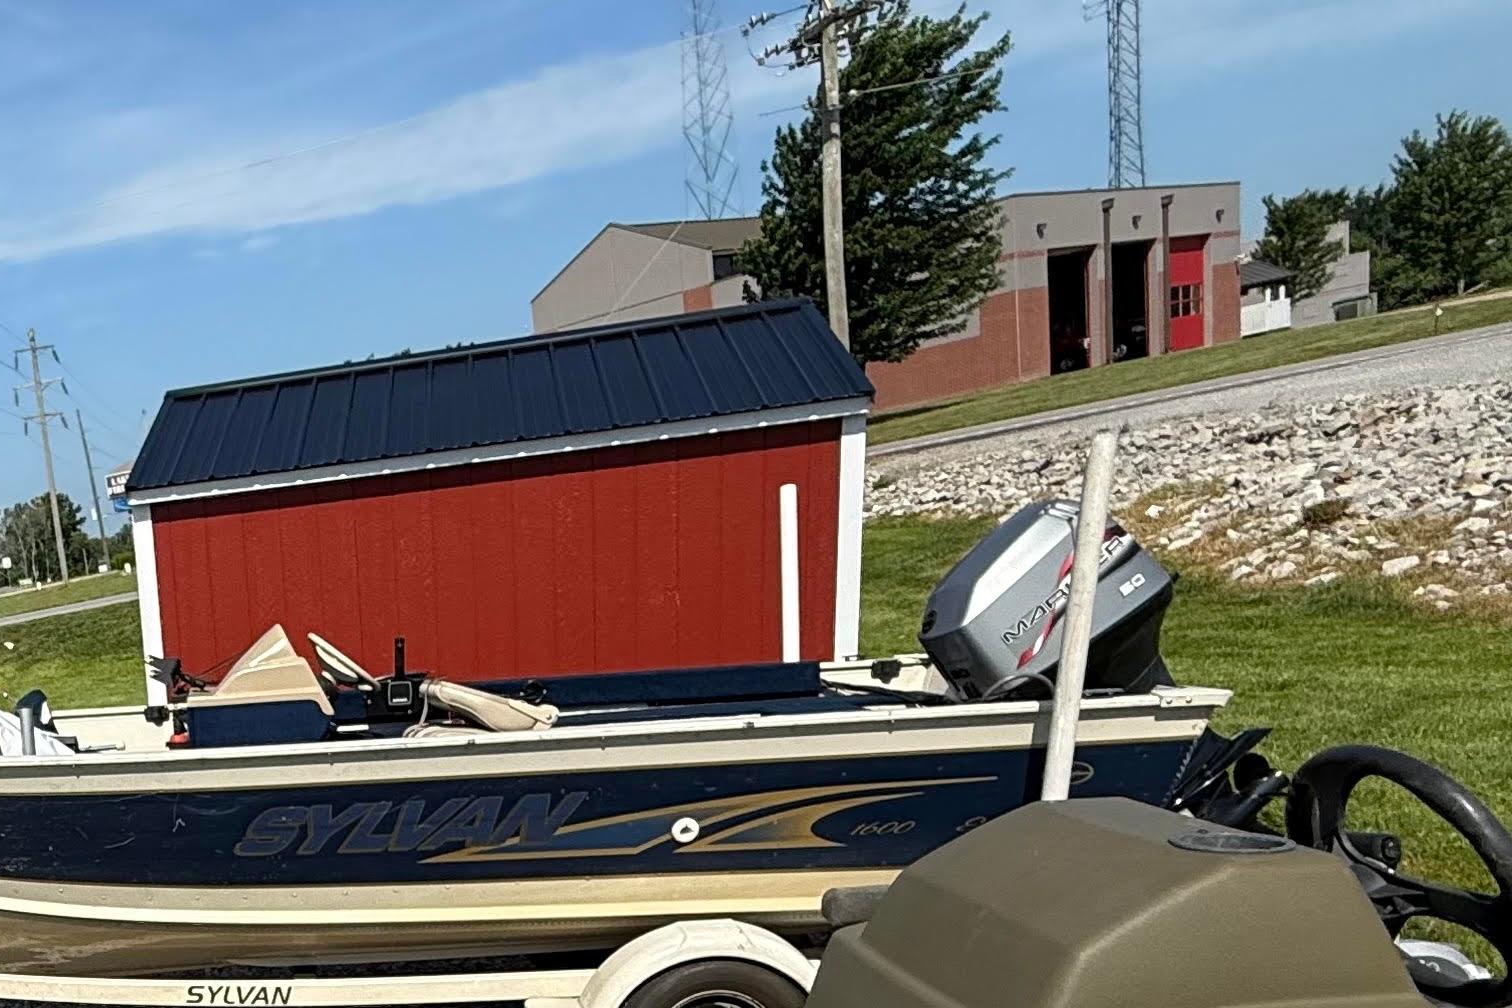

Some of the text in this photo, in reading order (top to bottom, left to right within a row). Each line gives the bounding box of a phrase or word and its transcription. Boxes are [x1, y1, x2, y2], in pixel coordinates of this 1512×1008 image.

[1119, 573, 1146, 598] 50
[233, 791, 590, 857] SYLVAN
[850, 820, 917, 837] 1600
[186, 985, 293, 1005] SYLVAN
